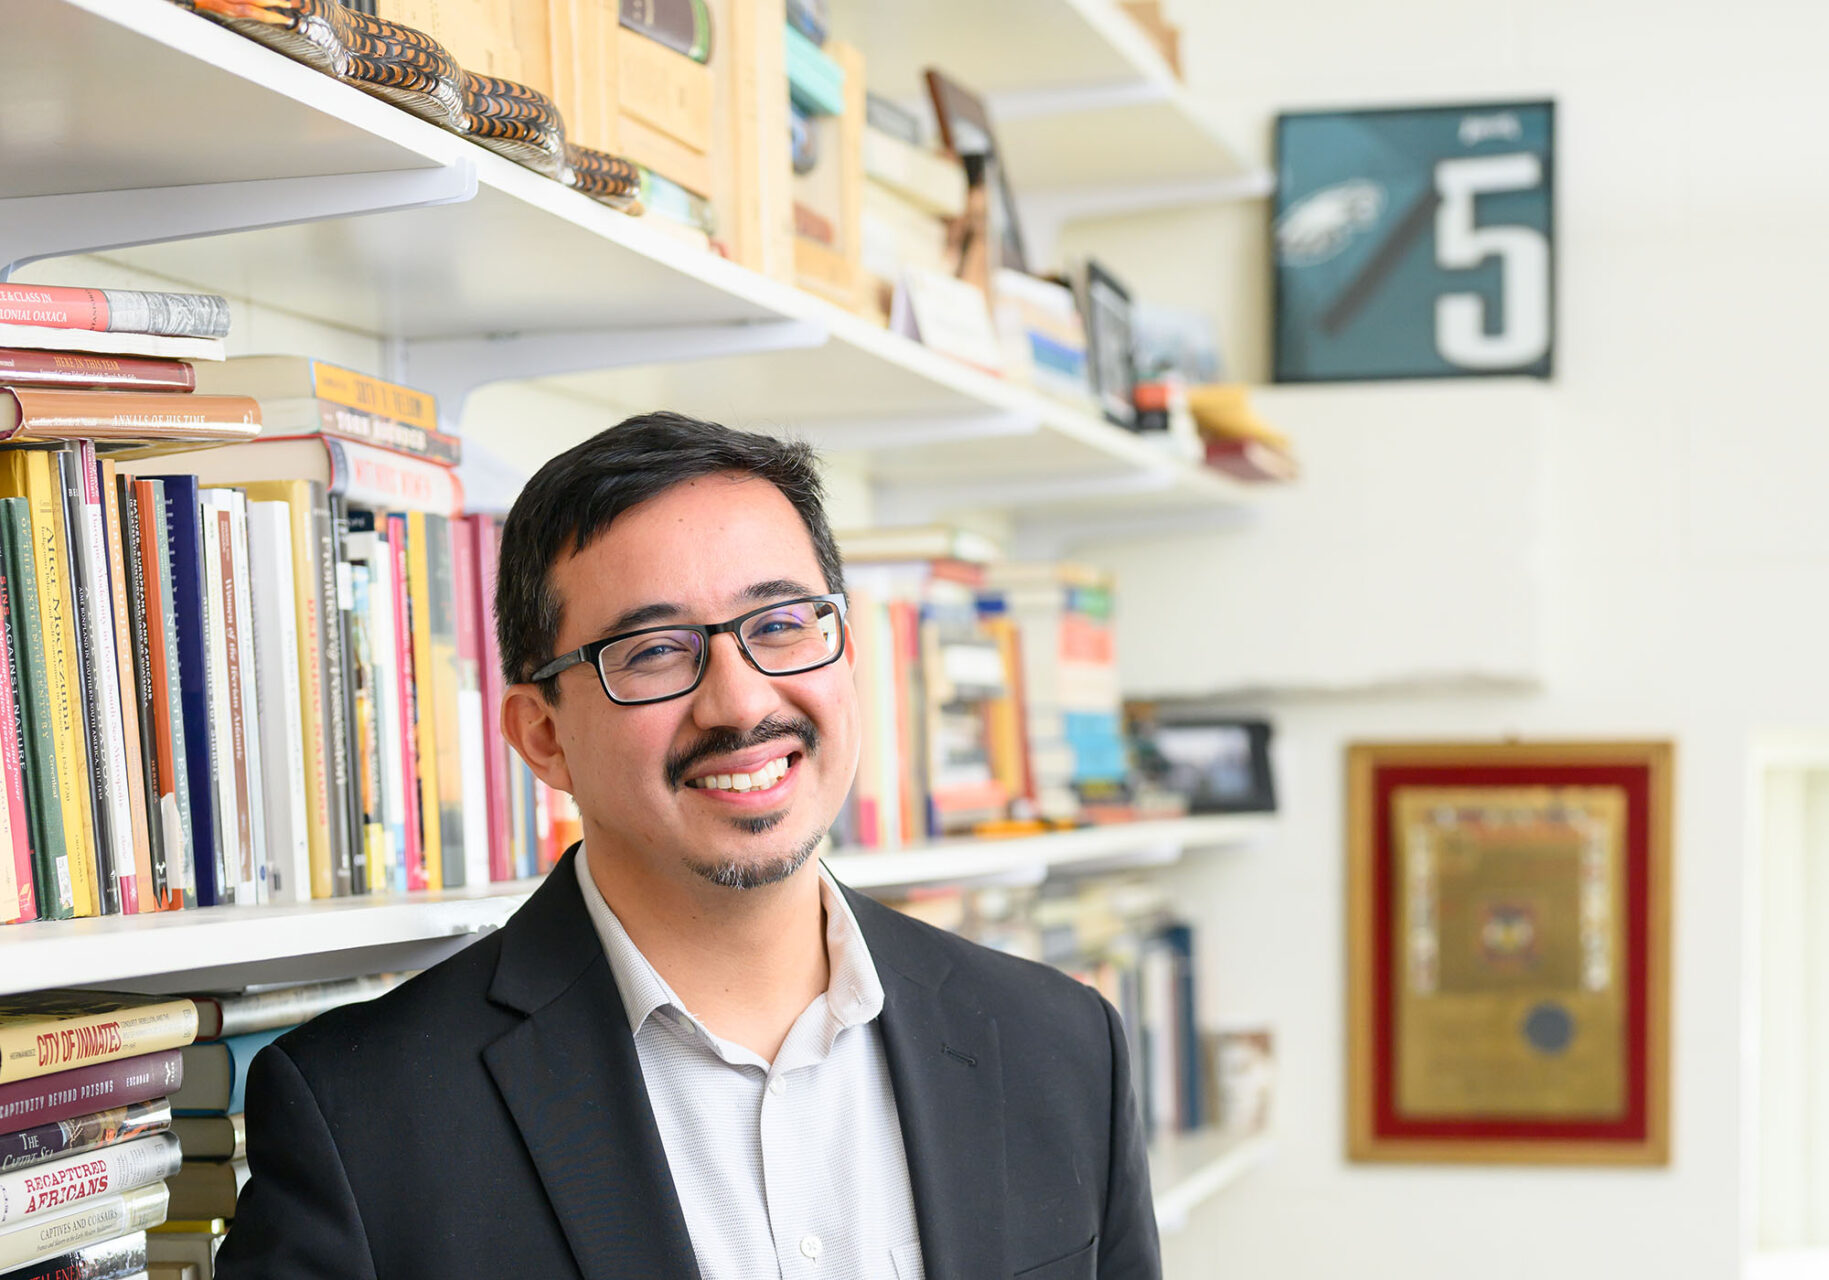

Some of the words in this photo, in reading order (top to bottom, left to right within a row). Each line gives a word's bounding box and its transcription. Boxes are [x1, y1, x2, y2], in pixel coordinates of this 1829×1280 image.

[1435, 150, 1551, 369] 5
[14, 291, 40, 303] CLASS
[41, 293, 52, 304] IN
[33, 311, 67, 323] OAXACA
[54, 357, 74, 368] HERE
[76, 358, 84, 369] IN
[85, 359, 100, 370] THIS
[101, 359, 120, 371] YEAR
[112, 415, 150, 426] ANNALS
[152, 416, 164, 427] OF
[165, 415, 182, 425] HIS
[183, 415, 205, 425] TIME
[21, 517, 27, 536] OF
[22, 542, 30, 571] THE
[45, 526, 58, 585] After
[0, 575, 9, 615] SINS
[107, 481, 121, 575] IMPERIAL
[116, 582, 130, 672] SUBJECTS
[26, 577, 40, 663] SIXTEENTH
[225, 578, 234, 623] Women
[78, 606, 89, 648] BONPLAND
[226, 626, 235, 639] of
[4, 622, 18, 698] AGAINST
[51, 597, 71, 731] Moctezuma
[84, 649, 89, 658] IN
[229, 643, 237, 661] the
[84, 660, 94, 700] SOUTHERN
[140, 656, 148, 707] GUATEMALA
[144, 647, 152, 699] AFRICANS
[164, 612, 183, 744] NEGOTIATED
[34, 669, 49, 738] CENTURY
[56, 702, 64, 730] Mexico
[88, 702, 96, 728] SOUTH
[12, 704, 25, 770] NATURE
[90, 729, 100, 764] AMERICA,
[93, 702, 112, 798] SHADOW
[233, 712, 243, 760] Atlantic
[11, 766, 21, 801] Power
[47, 754, 58, 798] Greenleaf
[37, 1033, 60, 1067] CITY
[62, 1030, 79, 1063] OF
[75, 1021, 122, 1059] INMATES
[0, 1096, 44, 1120] CAPTIVITY
[49, 1087, 77, 1106] BEYOND
[81, 1080, 114, 1100] PRISONS
[126, 1073, 150, 1087] ESCOBAR
[19, 1133, 39, 1151] THE
[24, 1160, 107, 1193] RECAPTURED
[25, 1175, 108, 1214] AFRICANS
[40, 1218, 70, 1241] CAPTIVES
[72, 1215, 87, 1231] AND
[87, 1209, 118, 1228] CORSAIRS
